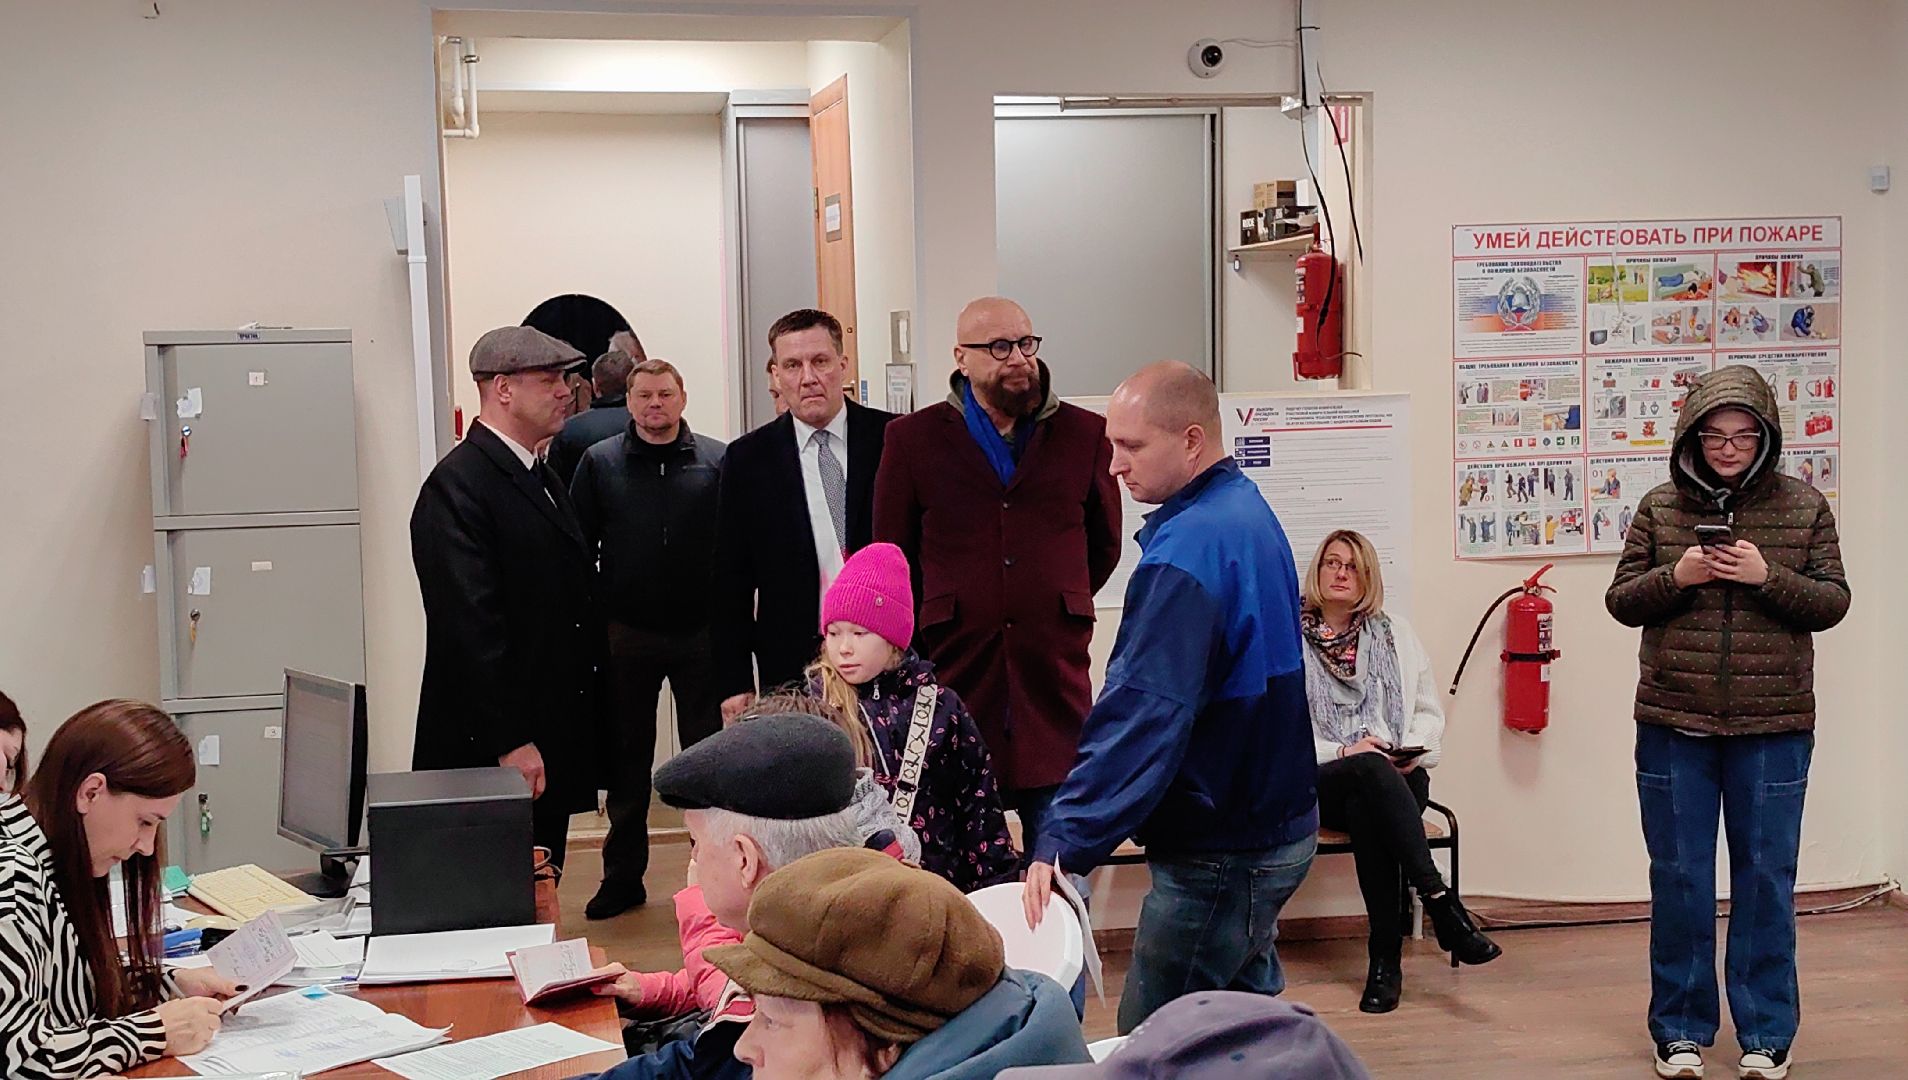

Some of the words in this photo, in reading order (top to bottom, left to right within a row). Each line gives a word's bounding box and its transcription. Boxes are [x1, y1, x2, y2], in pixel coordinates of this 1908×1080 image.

[1473, 227, 1531, 250] УМЕЙ
[1693, 226, 1733, 244] ПРИ
[1739, 224, 1823, 243] ПОЖАРЕ
